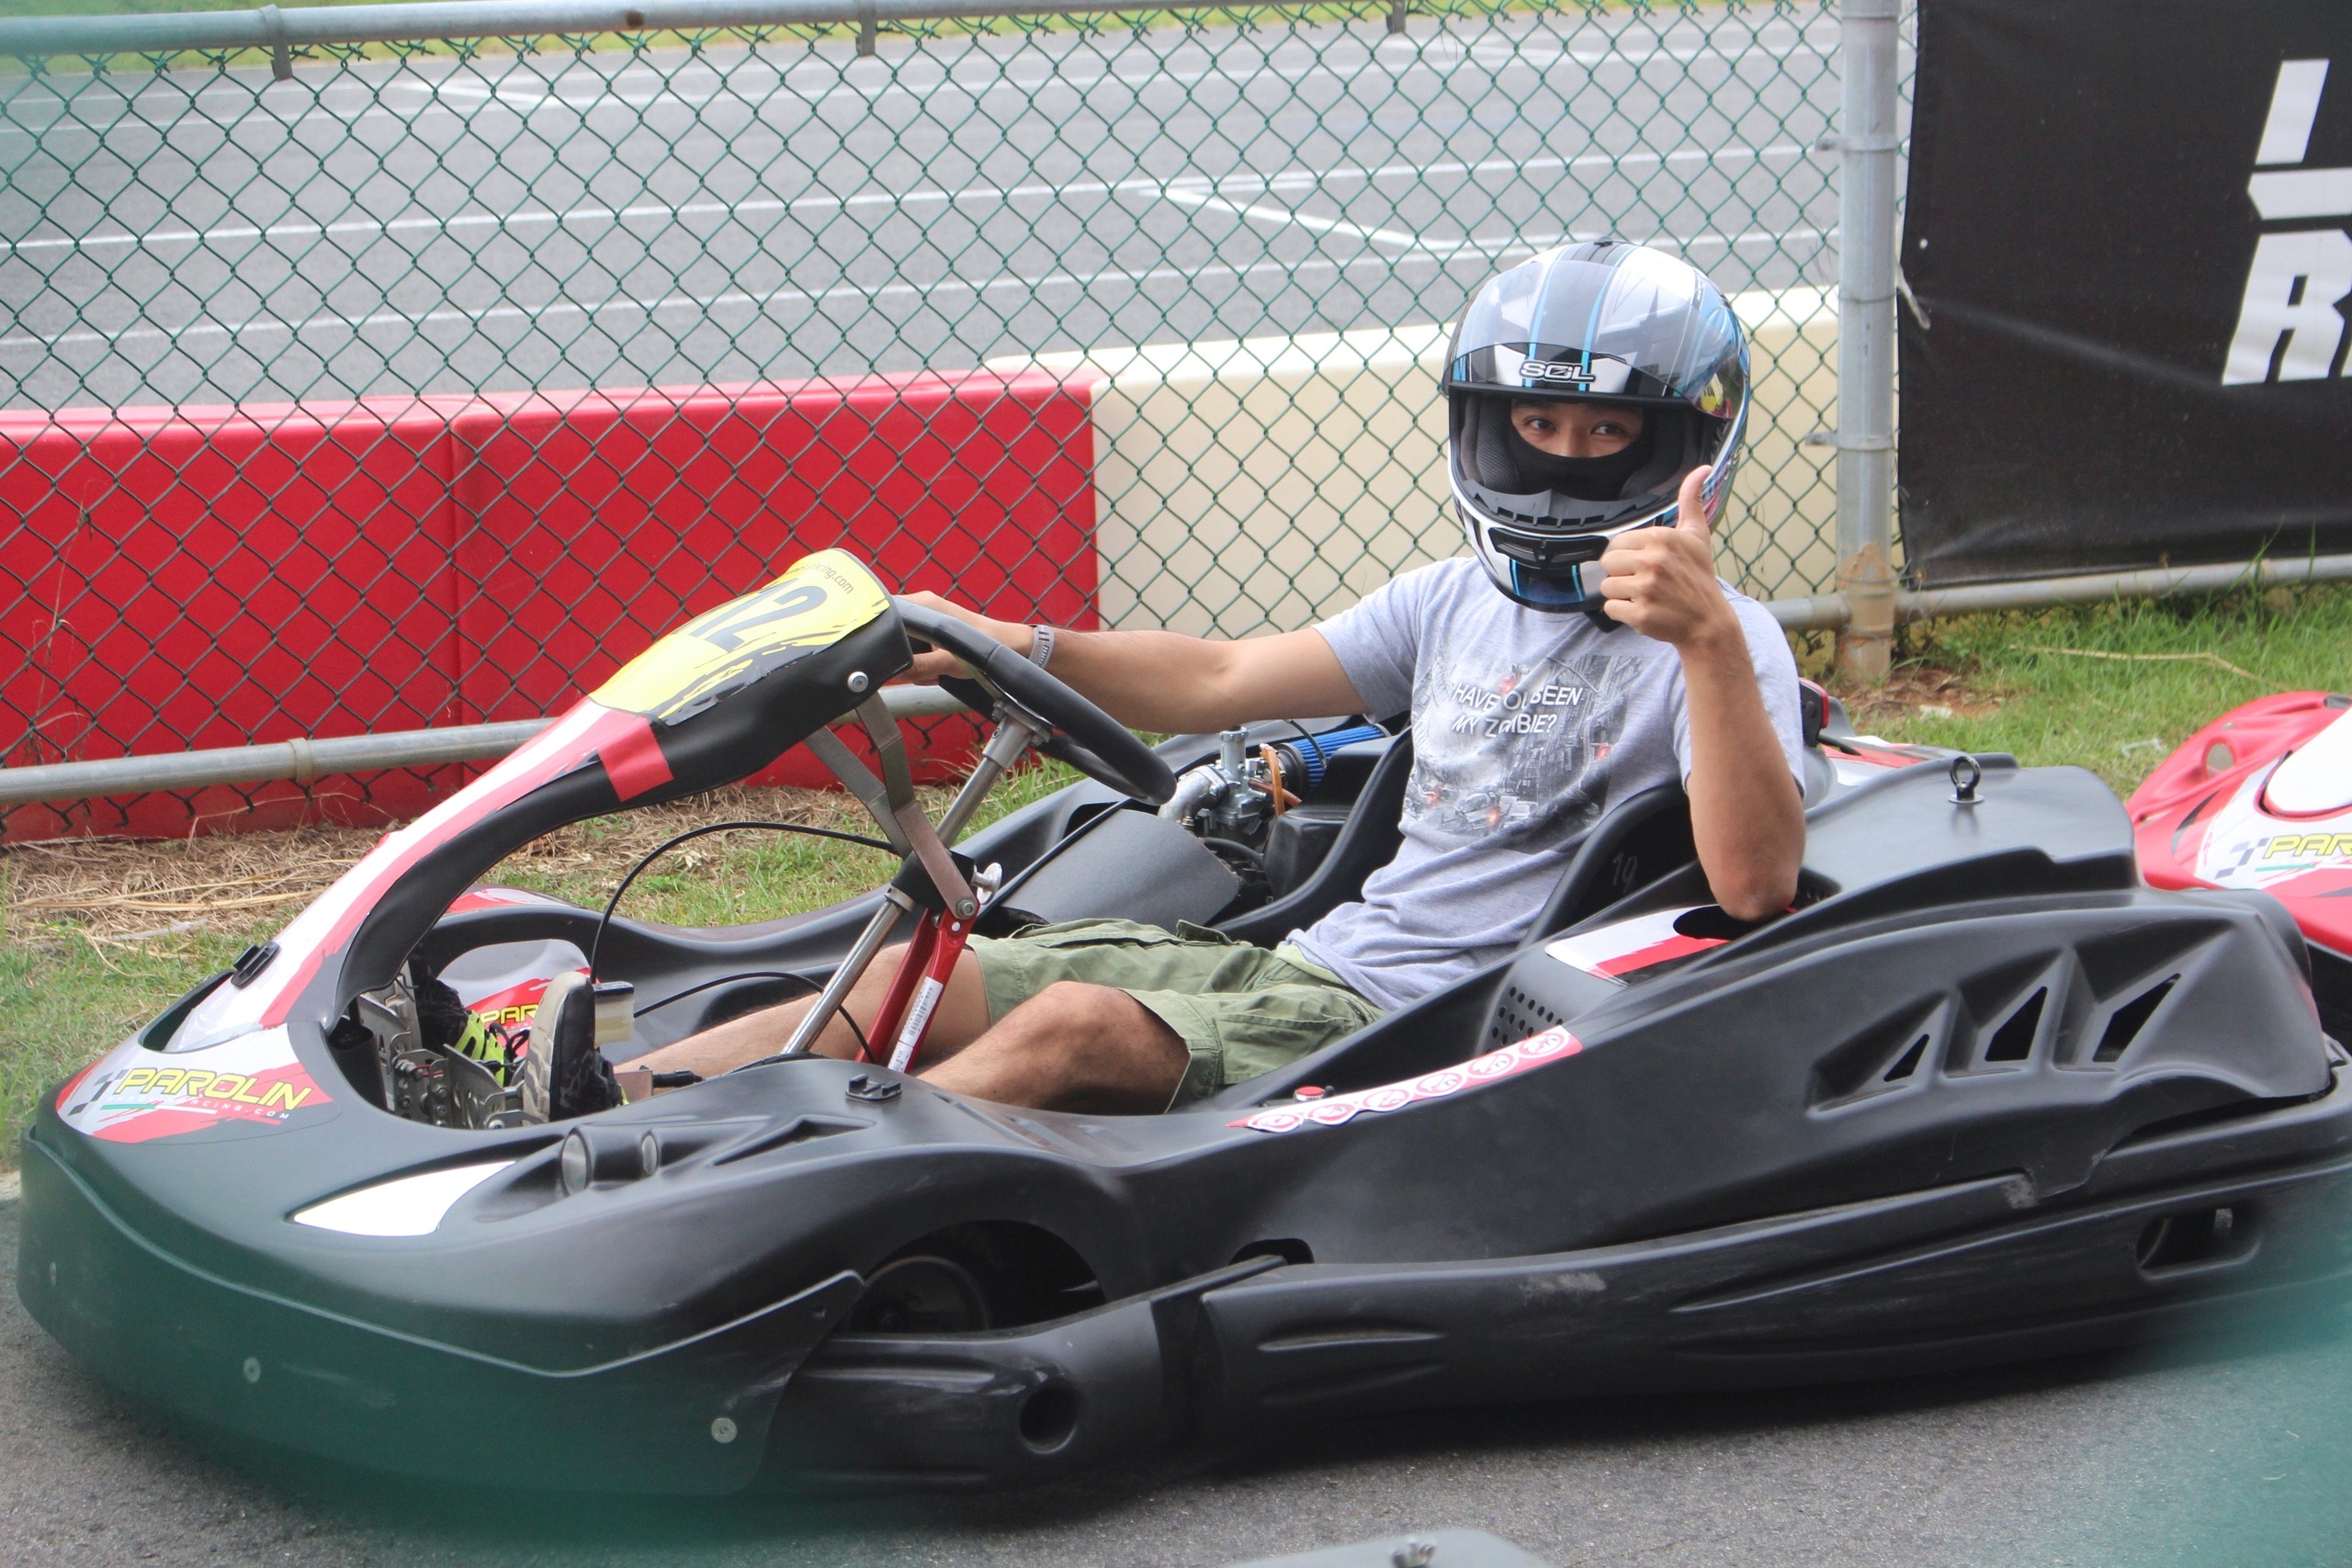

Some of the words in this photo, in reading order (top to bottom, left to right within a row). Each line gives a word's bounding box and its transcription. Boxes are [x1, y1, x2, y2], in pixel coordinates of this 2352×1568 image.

[2222, 229, 2352, 387] R
[688, 577, 828, 653] 12
[1452, 682, 1501, 712] HAVE
[1452, 714, 1482, 735] MY
[113, 1067, 313, 1111] PAROLIN
